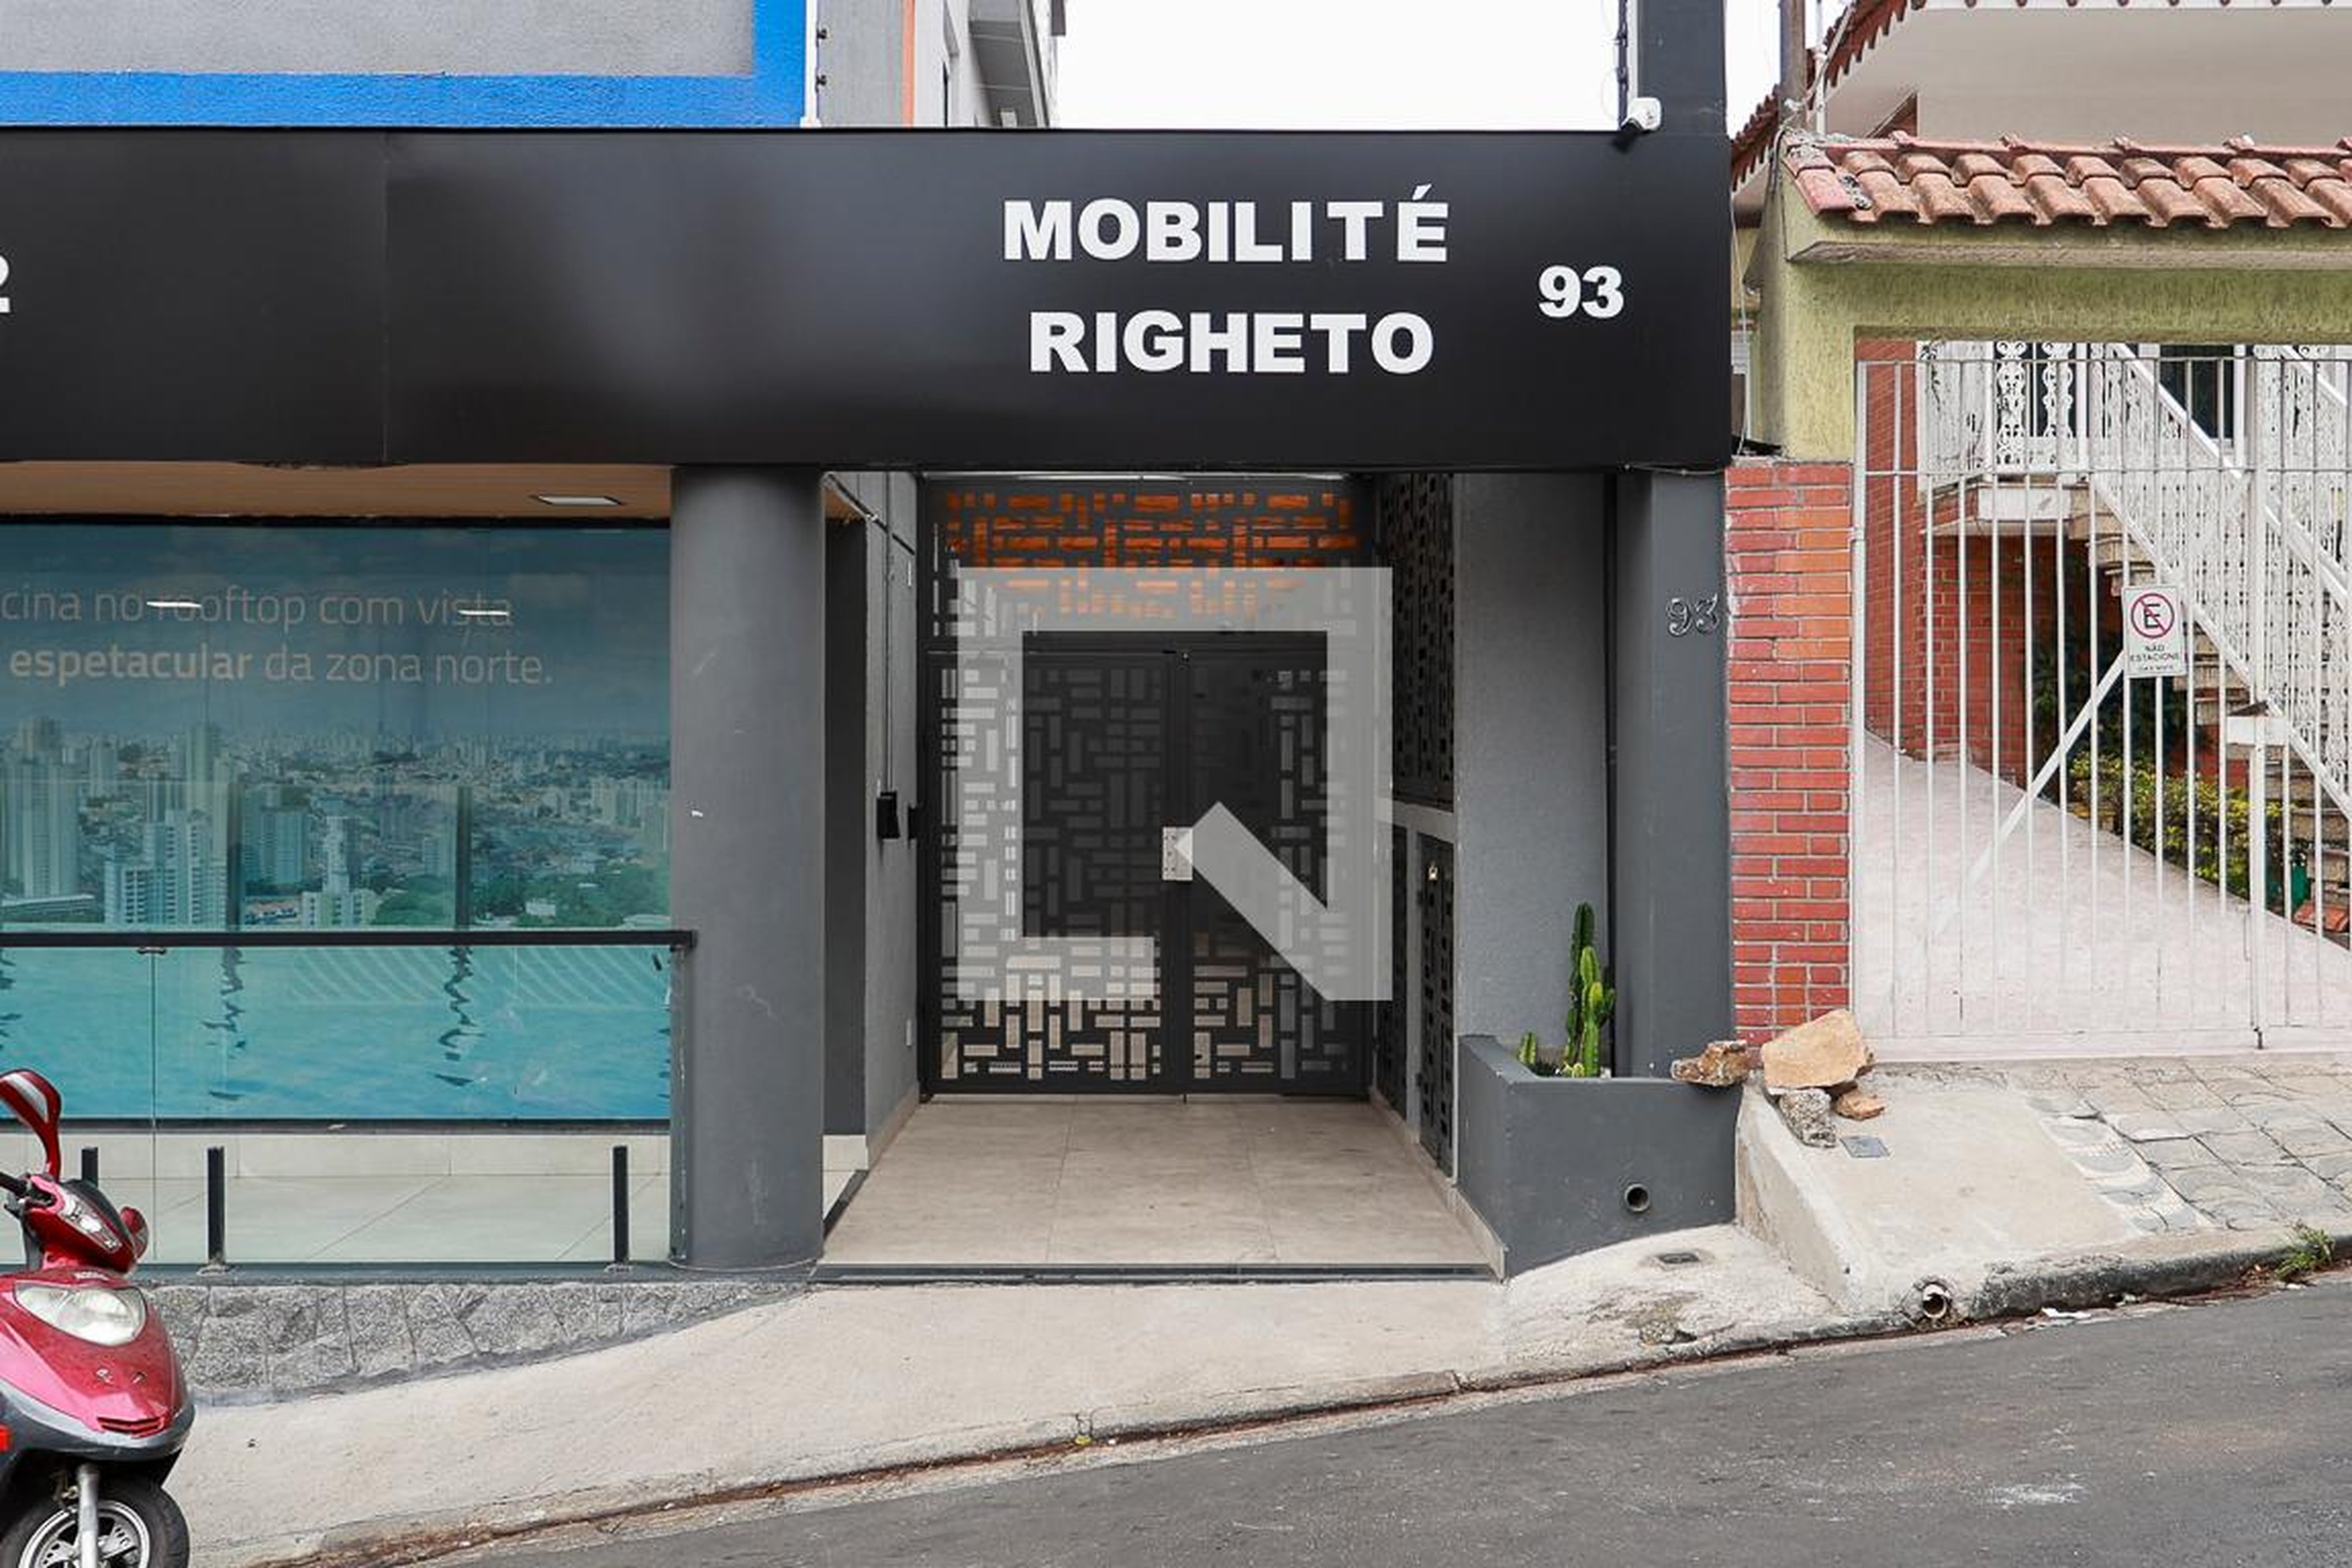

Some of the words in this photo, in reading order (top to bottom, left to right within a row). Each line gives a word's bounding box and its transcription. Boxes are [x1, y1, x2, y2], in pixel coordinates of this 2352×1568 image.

[1003, 183, 1449, 262] MOBILITÉ
[1539, 265, 1624, 318] 93
[1030, 310, 1433, 374] RIGHETO
[96, 590, 143, 621] no
[159, 586, 306, 633] rooftop
[319, 594, 403, 625] com
[418, 589, 513, 626] vista
[1666, 593, 1719, 638] 93
[10, 643, 252, 686] espetacular
[265, 644, 314, 682] da
[326, 653, 423, 682] zona
[436, 649, 552, 684] norte.
